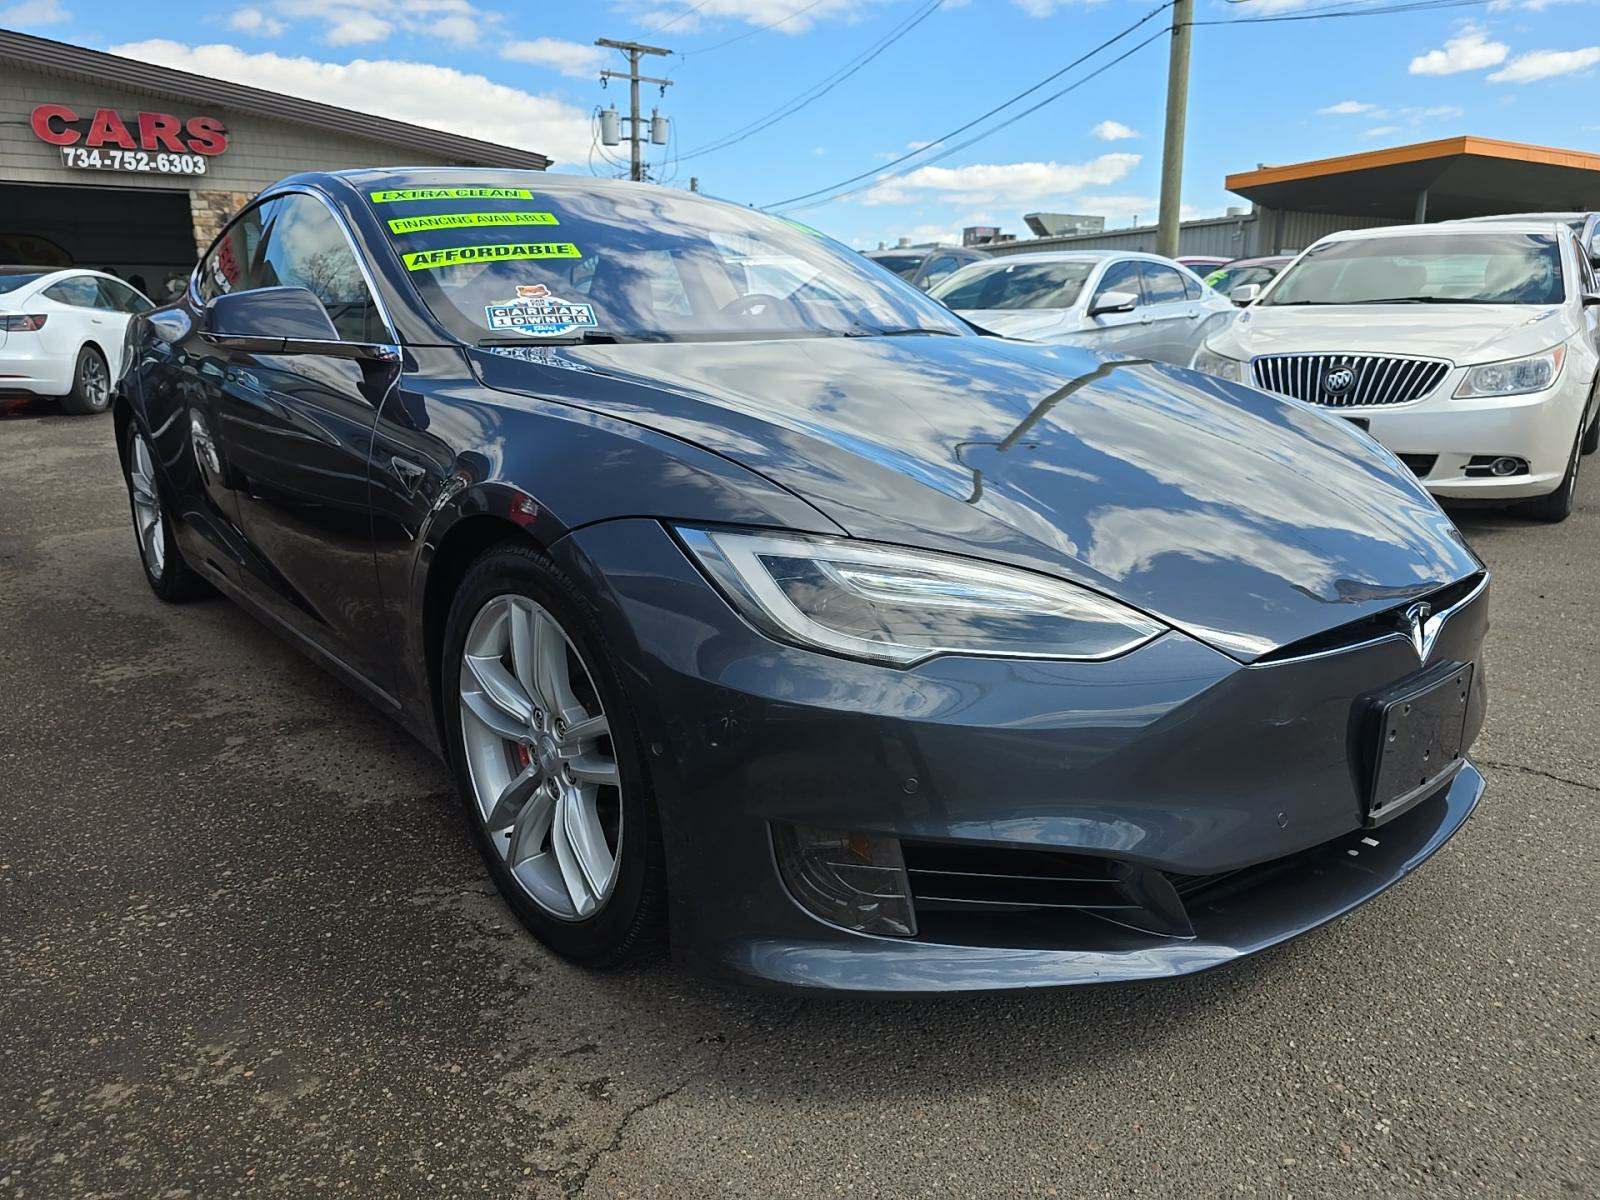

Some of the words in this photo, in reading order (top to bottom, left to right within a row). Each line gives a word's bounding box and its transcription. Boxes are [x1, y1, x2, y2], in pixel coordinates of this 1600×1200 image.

[31, 104, 229, 156] CARS
[63, 148, 206, 174] 734-752-6303
[382, 190, 449, 200] EXTRA
[455, 189, 519, 198] CLEAN
[394, 216, 473, 230] FINANCING
[477, 214, 550, 224] AVAILABLE
[412, 244, 570, 266] AFFORDABLE
[494, 307, 585, 317] CARFAX
[513, 316, 588, 325] OWNER
